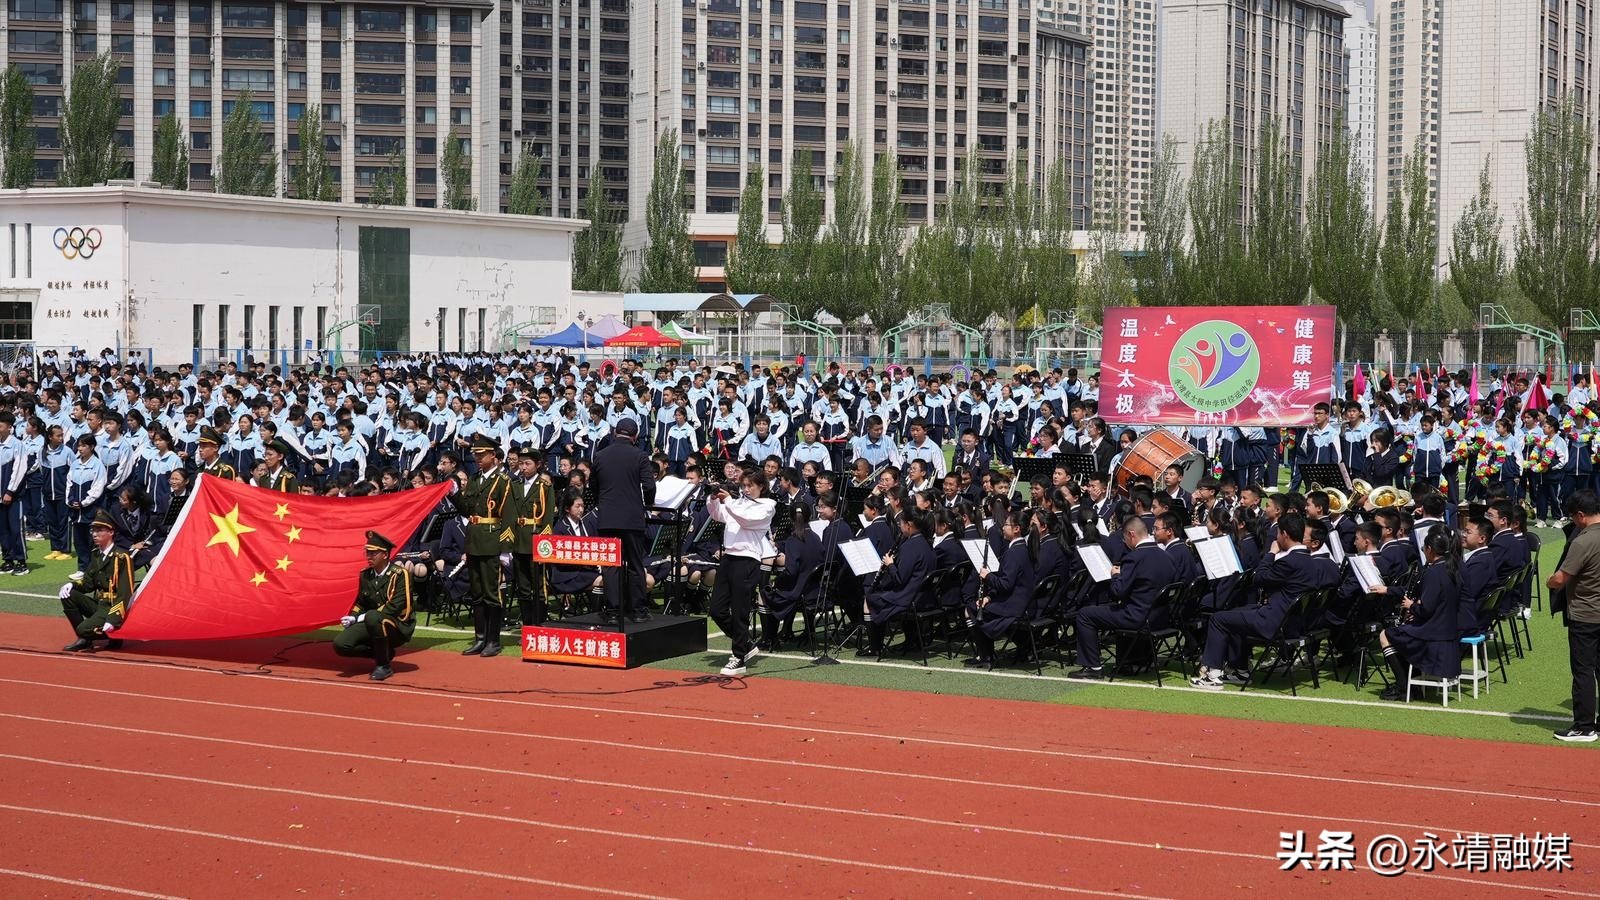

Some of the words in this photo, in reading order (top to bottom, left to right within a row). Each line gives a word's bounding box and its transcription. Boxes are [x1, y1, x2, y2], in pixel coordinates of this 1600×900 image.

[1115, 318, 1139, 415] 温度太极
[1289, 317, 1315, 409] 健康第一
[1174, 378, 1253, 408] 永靖县太极中学田径运动会
[555, 540, 617, 552] 永靖县太极中学
[526, 634, 621, 658] 为精彩人生做准备
